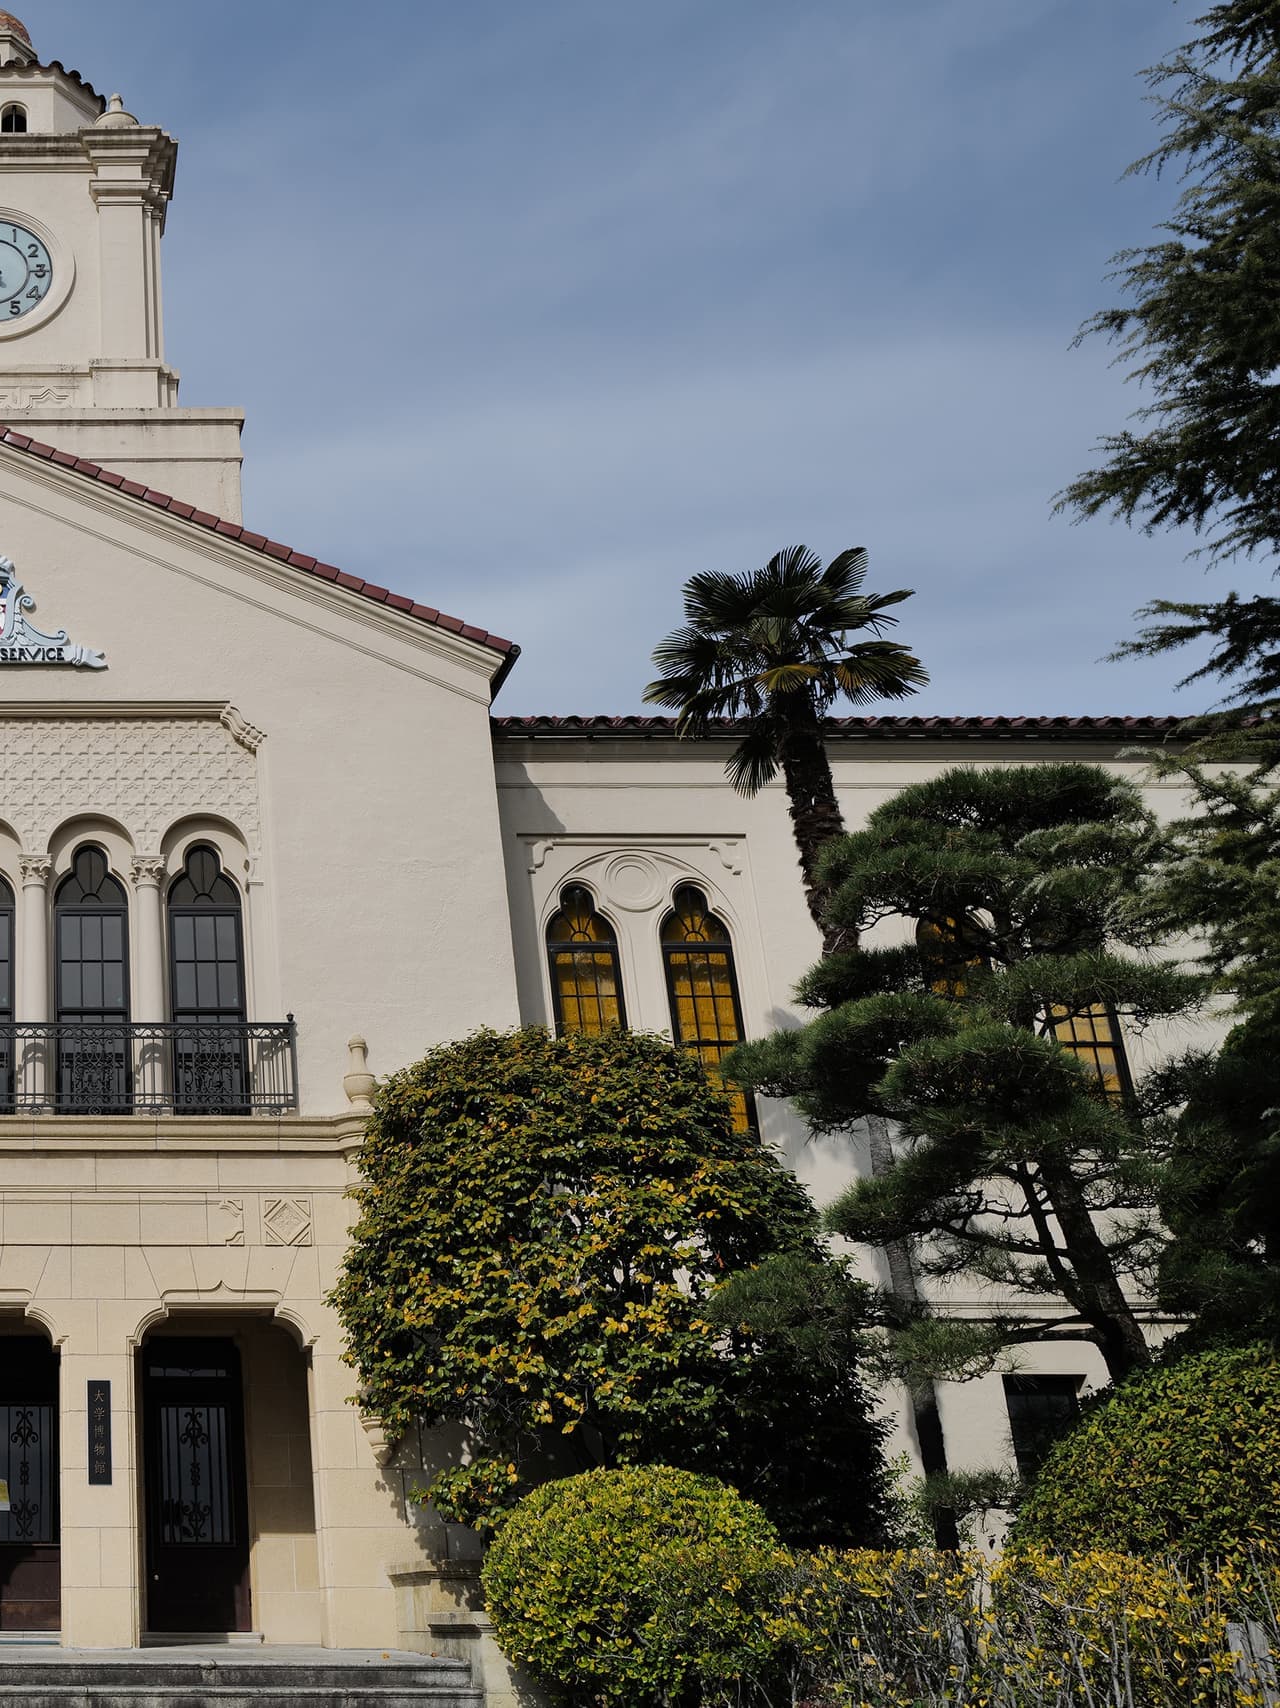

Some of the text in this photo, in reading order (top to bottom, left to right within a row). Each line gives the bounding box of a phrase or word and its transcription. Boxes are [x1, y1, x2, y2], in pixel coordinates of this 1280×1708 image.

[12, 229, 17, 242] 1
[28, 244, 39, 258] 2
[34, 264, 46, 278] 3
[26, 285, 41, 300] 4
[9, 301, 21, 315] 5
[0, 648, 65, 661] SERVICE
[94, 1389, 106, 1474] 大学博物館
